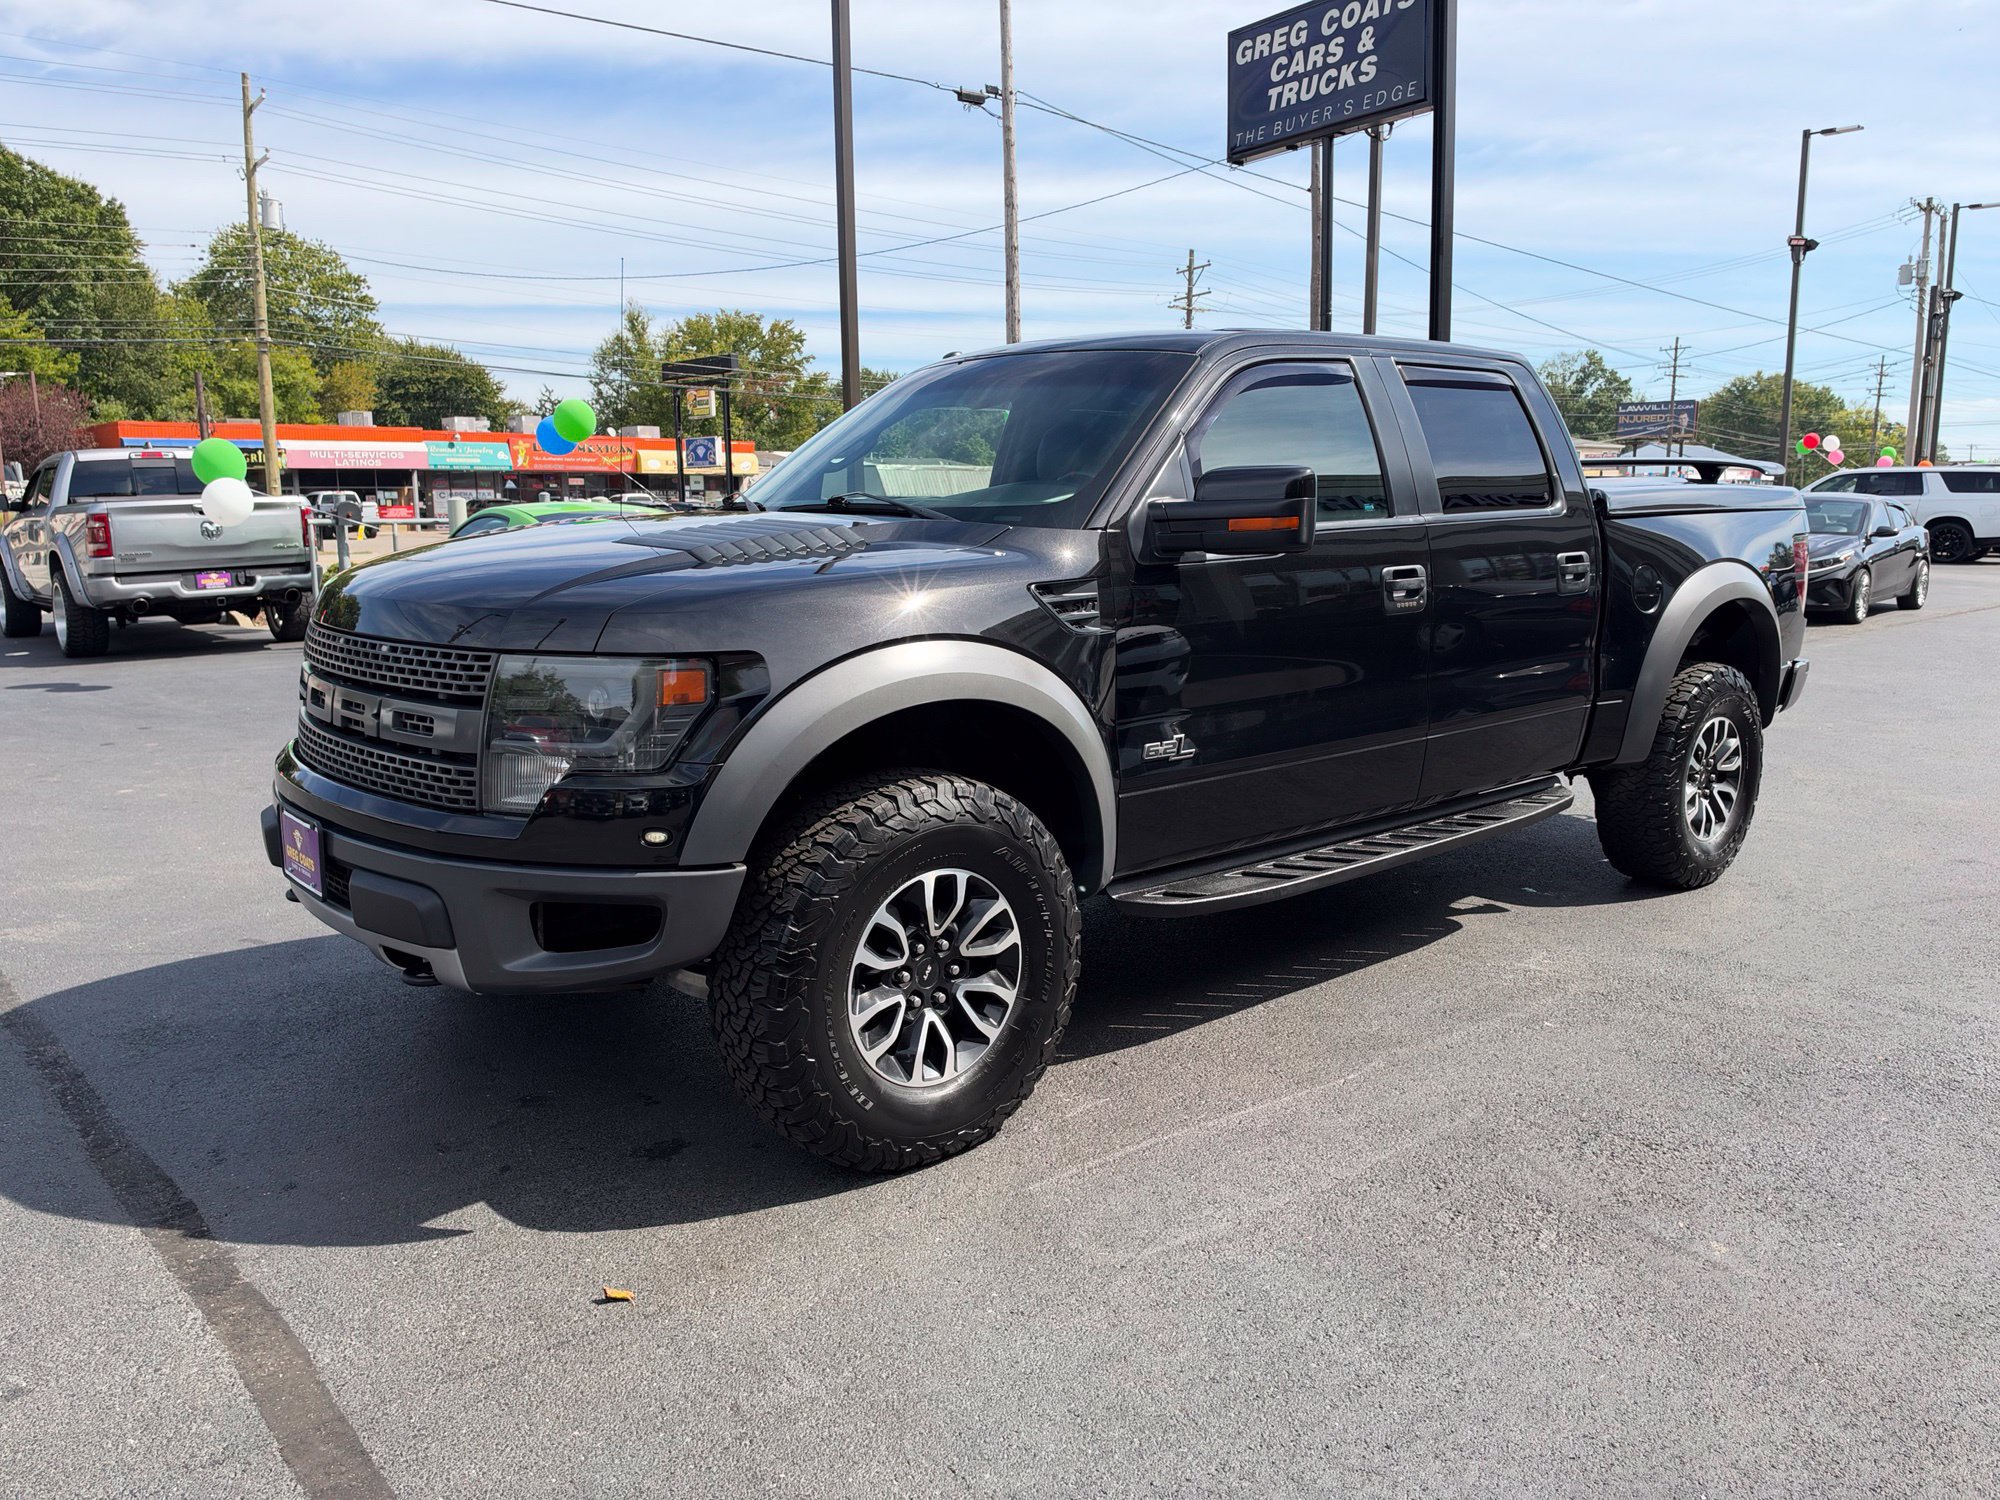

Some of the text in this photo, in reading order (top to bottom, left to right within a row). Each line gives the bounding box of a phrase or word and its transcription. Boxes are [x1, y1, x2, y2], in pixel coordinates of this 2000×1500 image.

[1235, 20, 1308, 65] GREG
[1270, 26, 1376, 82] CARS &
[1267, 54, 1378, 112] TRUCKS
[1235, 81, 1417, 147] THE BUYER'S EDGE
[309, 450, 405, 460] MULTI-SERVICIOS
[334, 458, 382, 467] LATINOS
